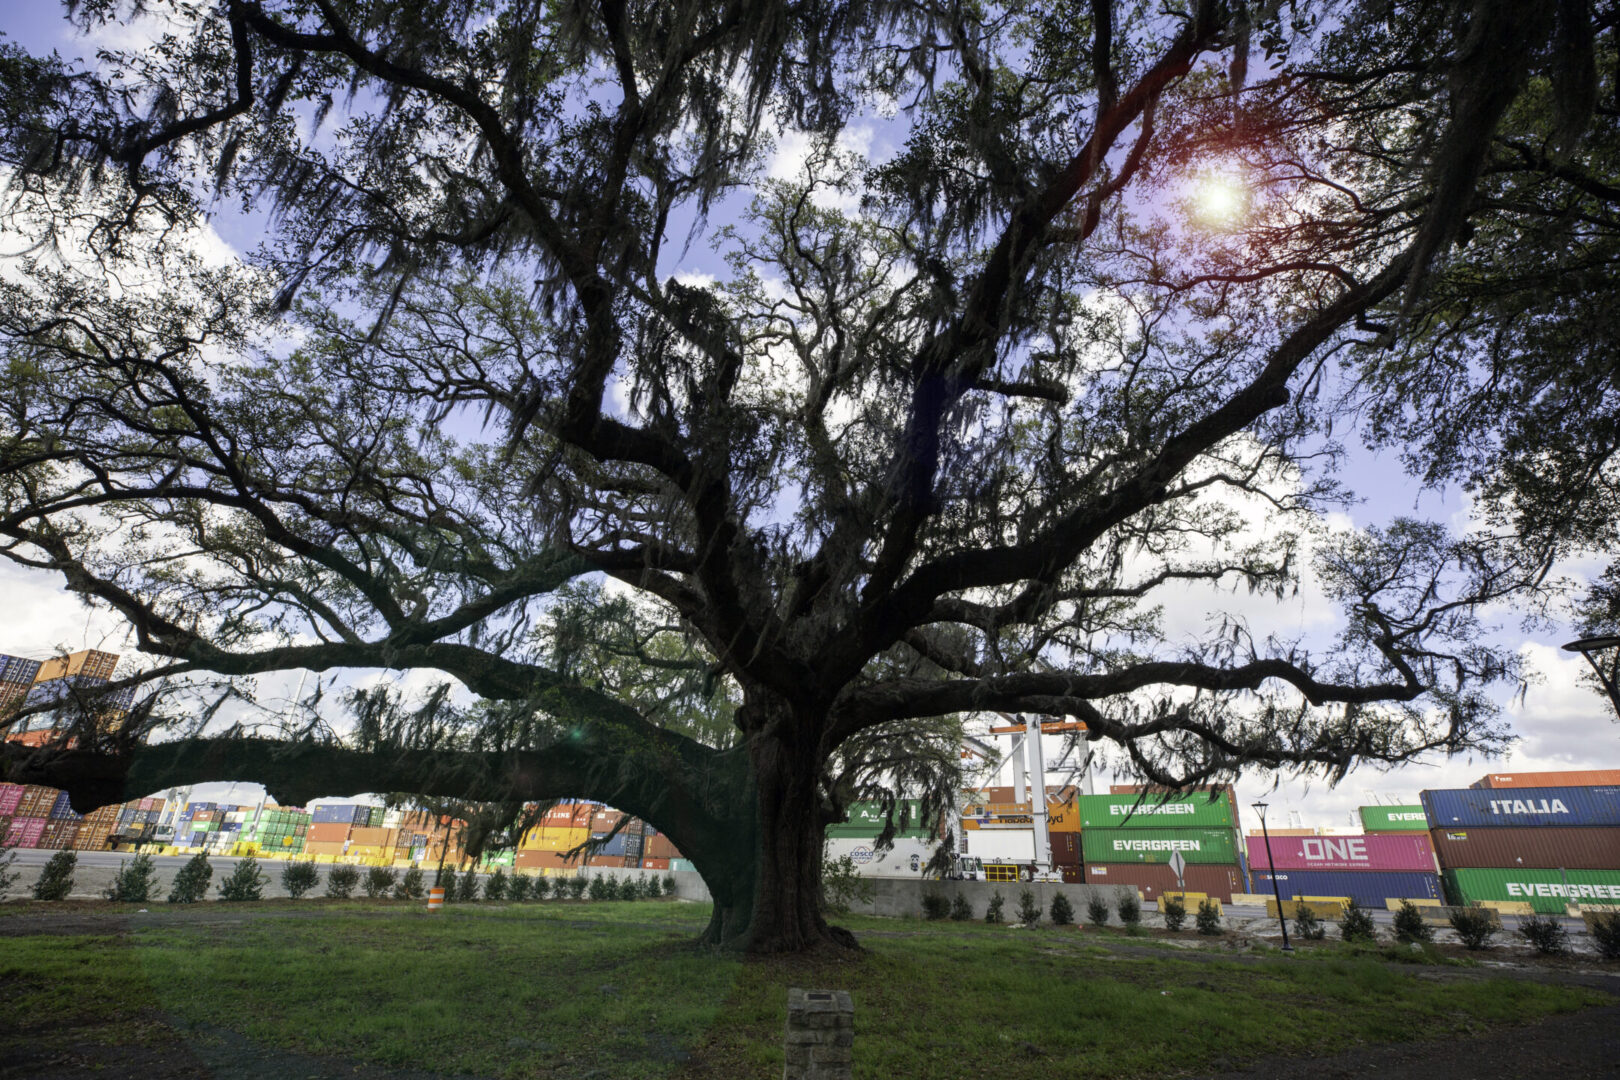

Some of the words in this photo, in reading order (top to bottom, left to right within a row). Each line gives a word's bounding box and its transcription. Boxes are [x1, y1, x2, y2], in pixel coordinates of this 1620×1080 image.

[1109, 803, 1195, 815] EVERGREEN
[1490, 798, 1569, 814] ITALIA
[1113, 839, 1201, 851] EVERGREEN
[1302, 838, 1369, 860] ONE
